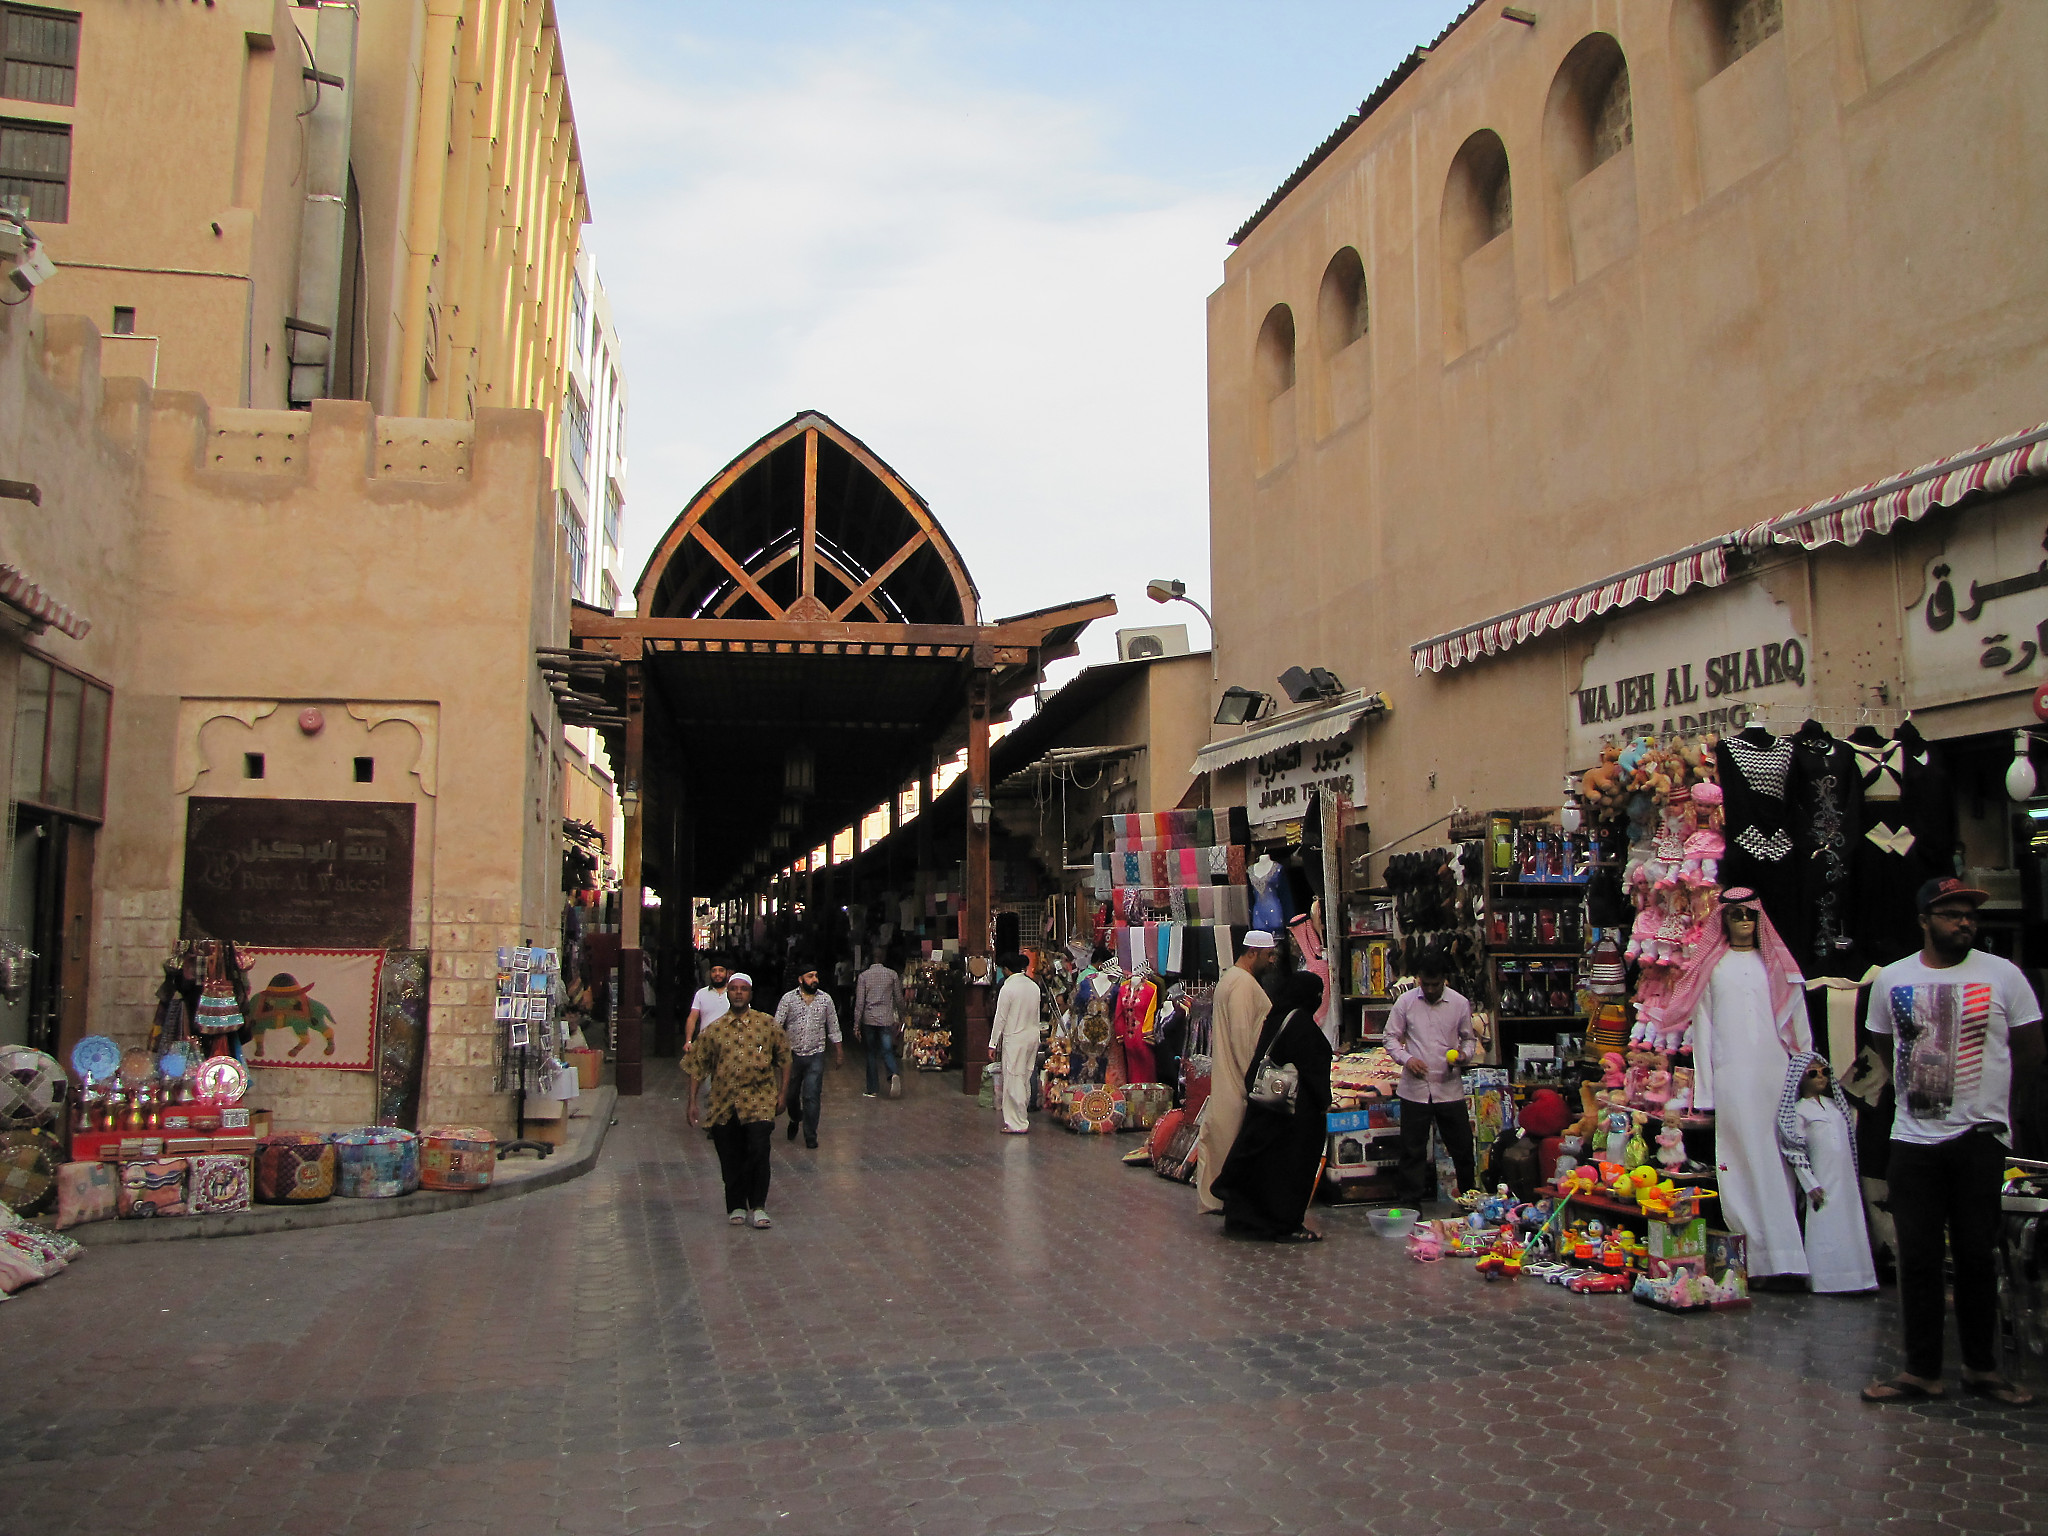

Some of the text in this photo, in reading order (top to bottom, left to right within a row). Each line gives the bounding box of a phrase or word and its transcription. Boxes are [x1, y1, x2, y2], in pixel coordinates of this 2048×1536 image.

[1577, 638, 1805, 725] WAJEH AL SHARQ
[1258, 787, 1297, 809] JAIPUR
